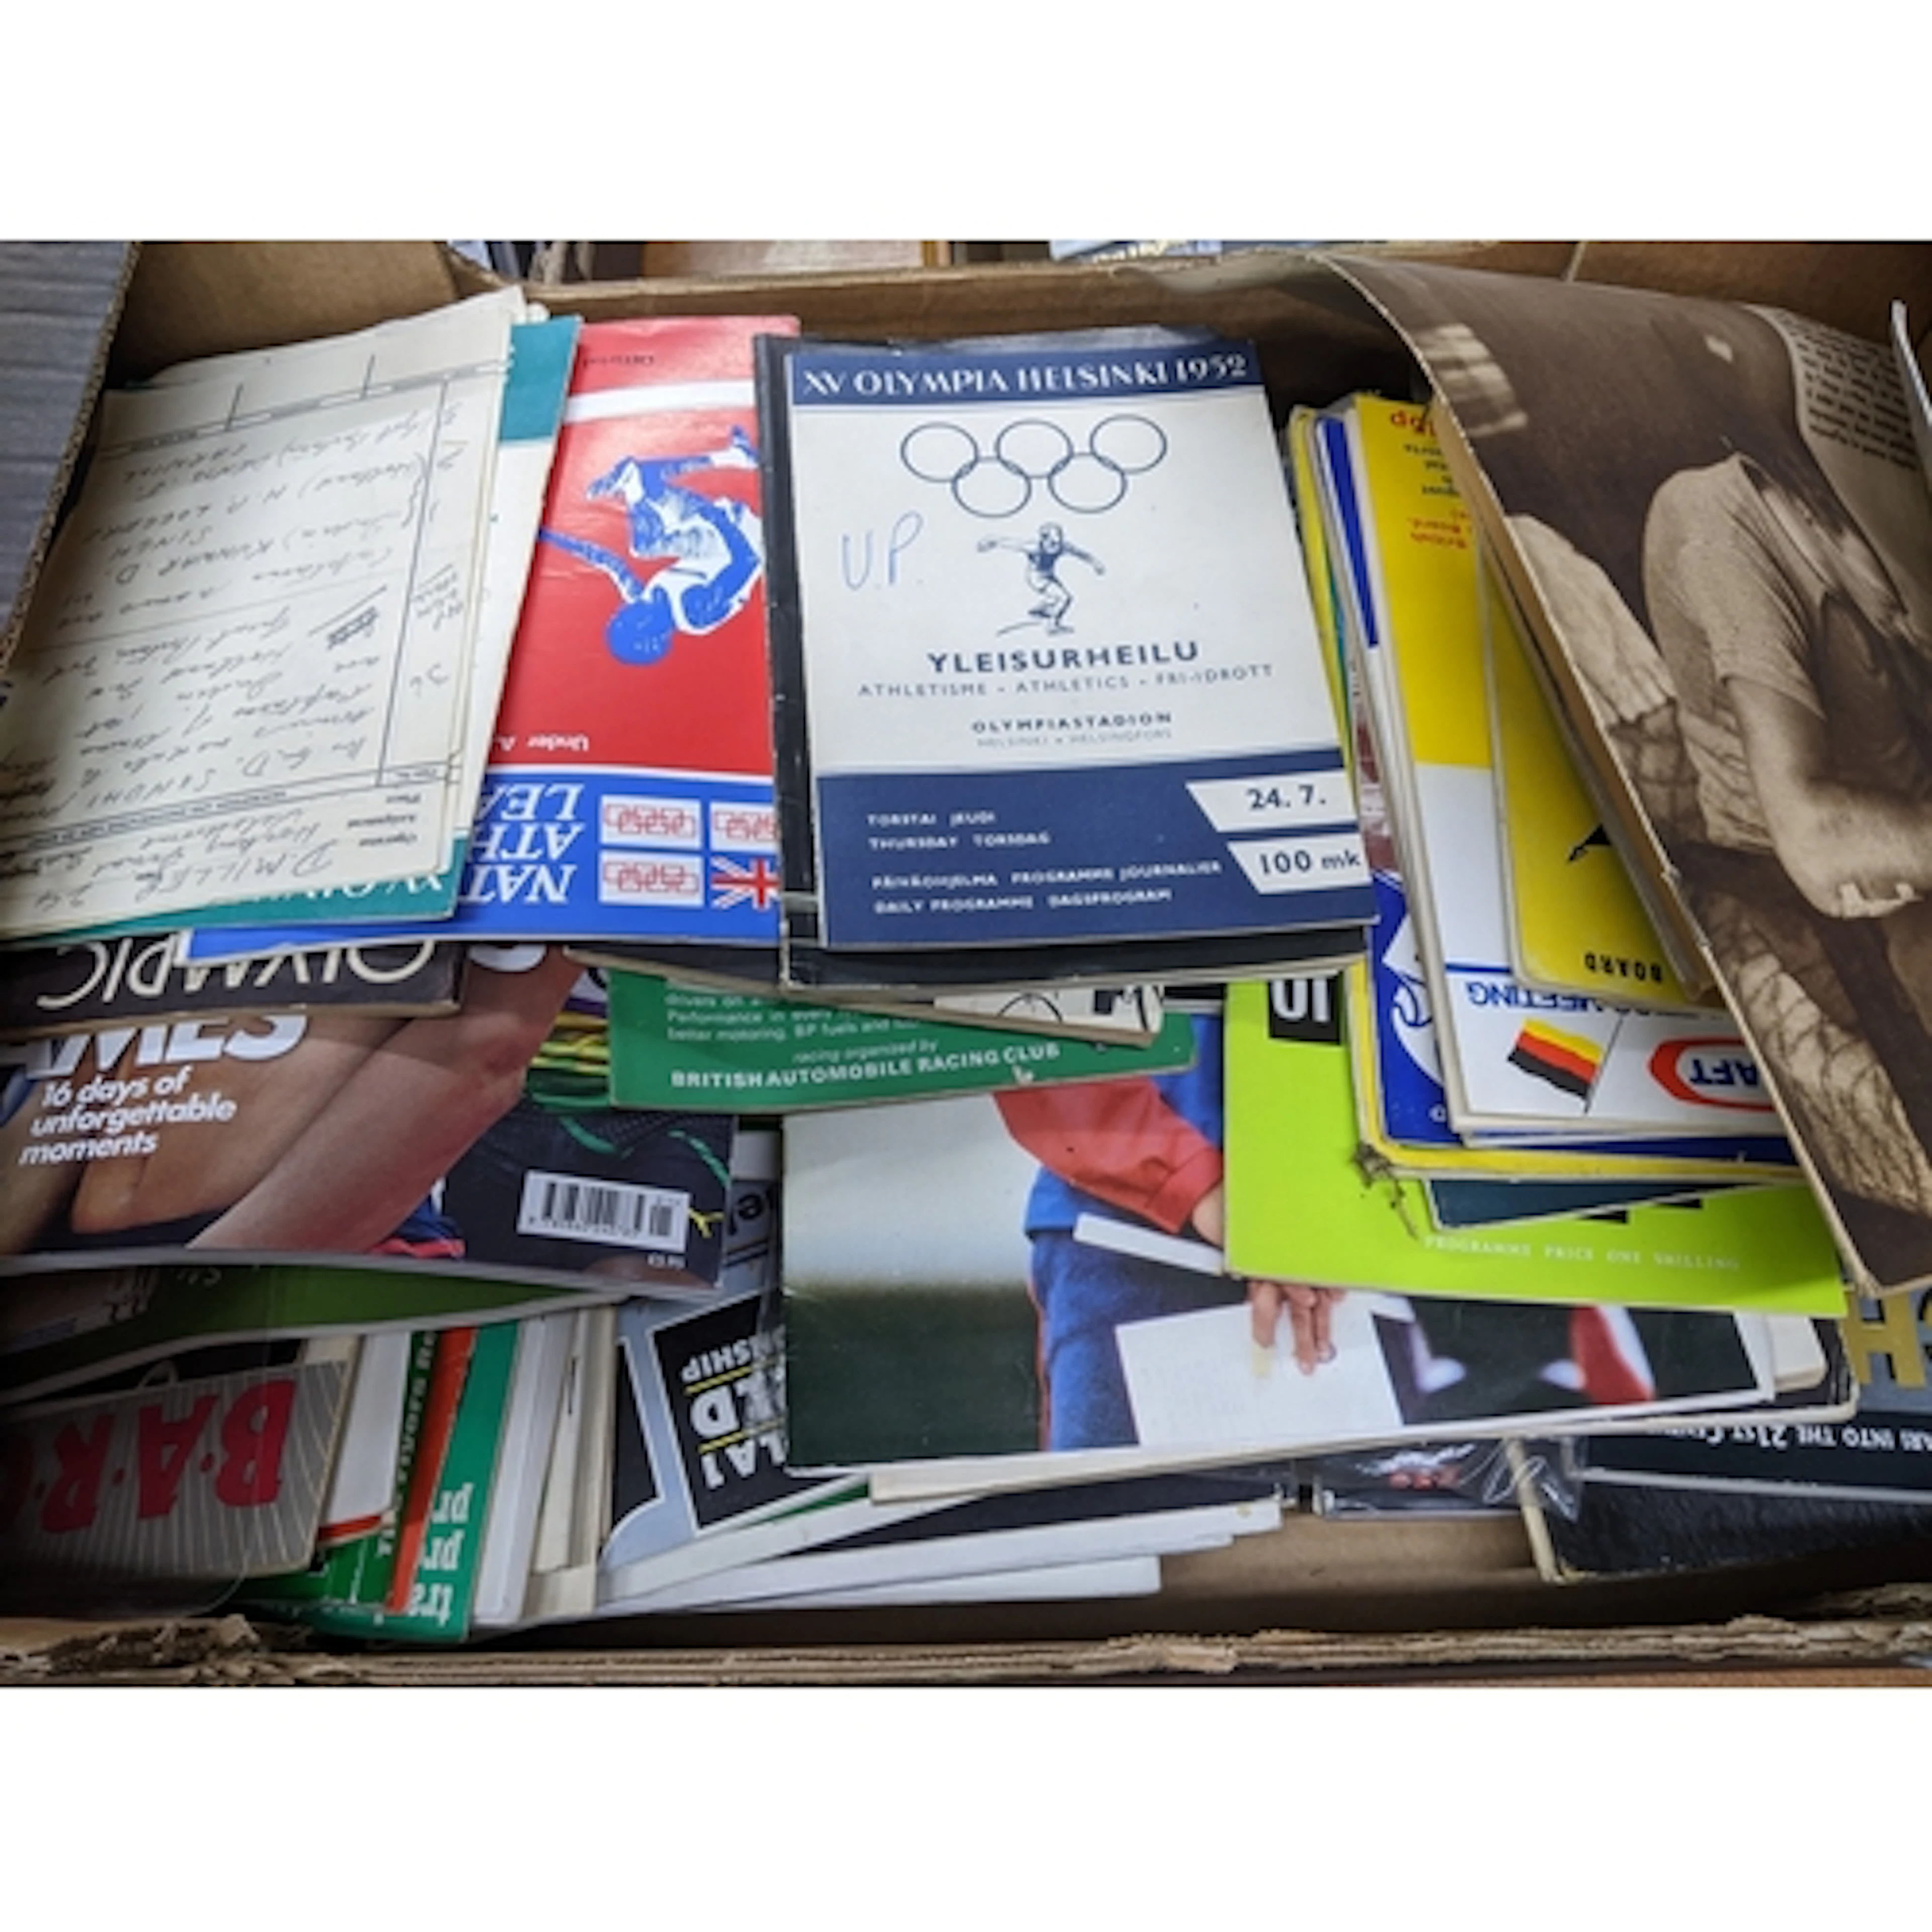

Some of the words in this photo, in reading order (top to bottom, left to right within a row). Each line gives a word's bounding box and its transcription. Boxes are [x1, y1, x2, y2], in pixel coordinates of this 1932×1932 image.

[803, 370, 847, 395] XV
[854, 368, 1008, 396] OLYMPIA
[1017, 359, 1169, 393] HELSINKI
[1175, 353, 1247, 383] 1952
[927, 640, 1199, 673] YLEISURHEILU
[858, 681, 988, 697] ATHLETISME
[1016, 674, 1129, 693] ATHLETICS
[971, 711, 1172, 734] OLYMPIASTADION
[1261, 850, 1312, 875] 100
[1584, 952, 1661, 984] BOARD
[670, 1069, 763, 1089] BRITISH
[765, 1057, 912, 1088] AUTOMOBILE
[917, 1047, 1000, 1073] RACING
[1002, 1041, 1061, 1065] CLUB
[75, 1074, 148, 1110] days
[153, 1065, 193, 1095] of
[31, 1094, 237, 1138] unforgettable
[19, 1131, 157, 1166] moments
